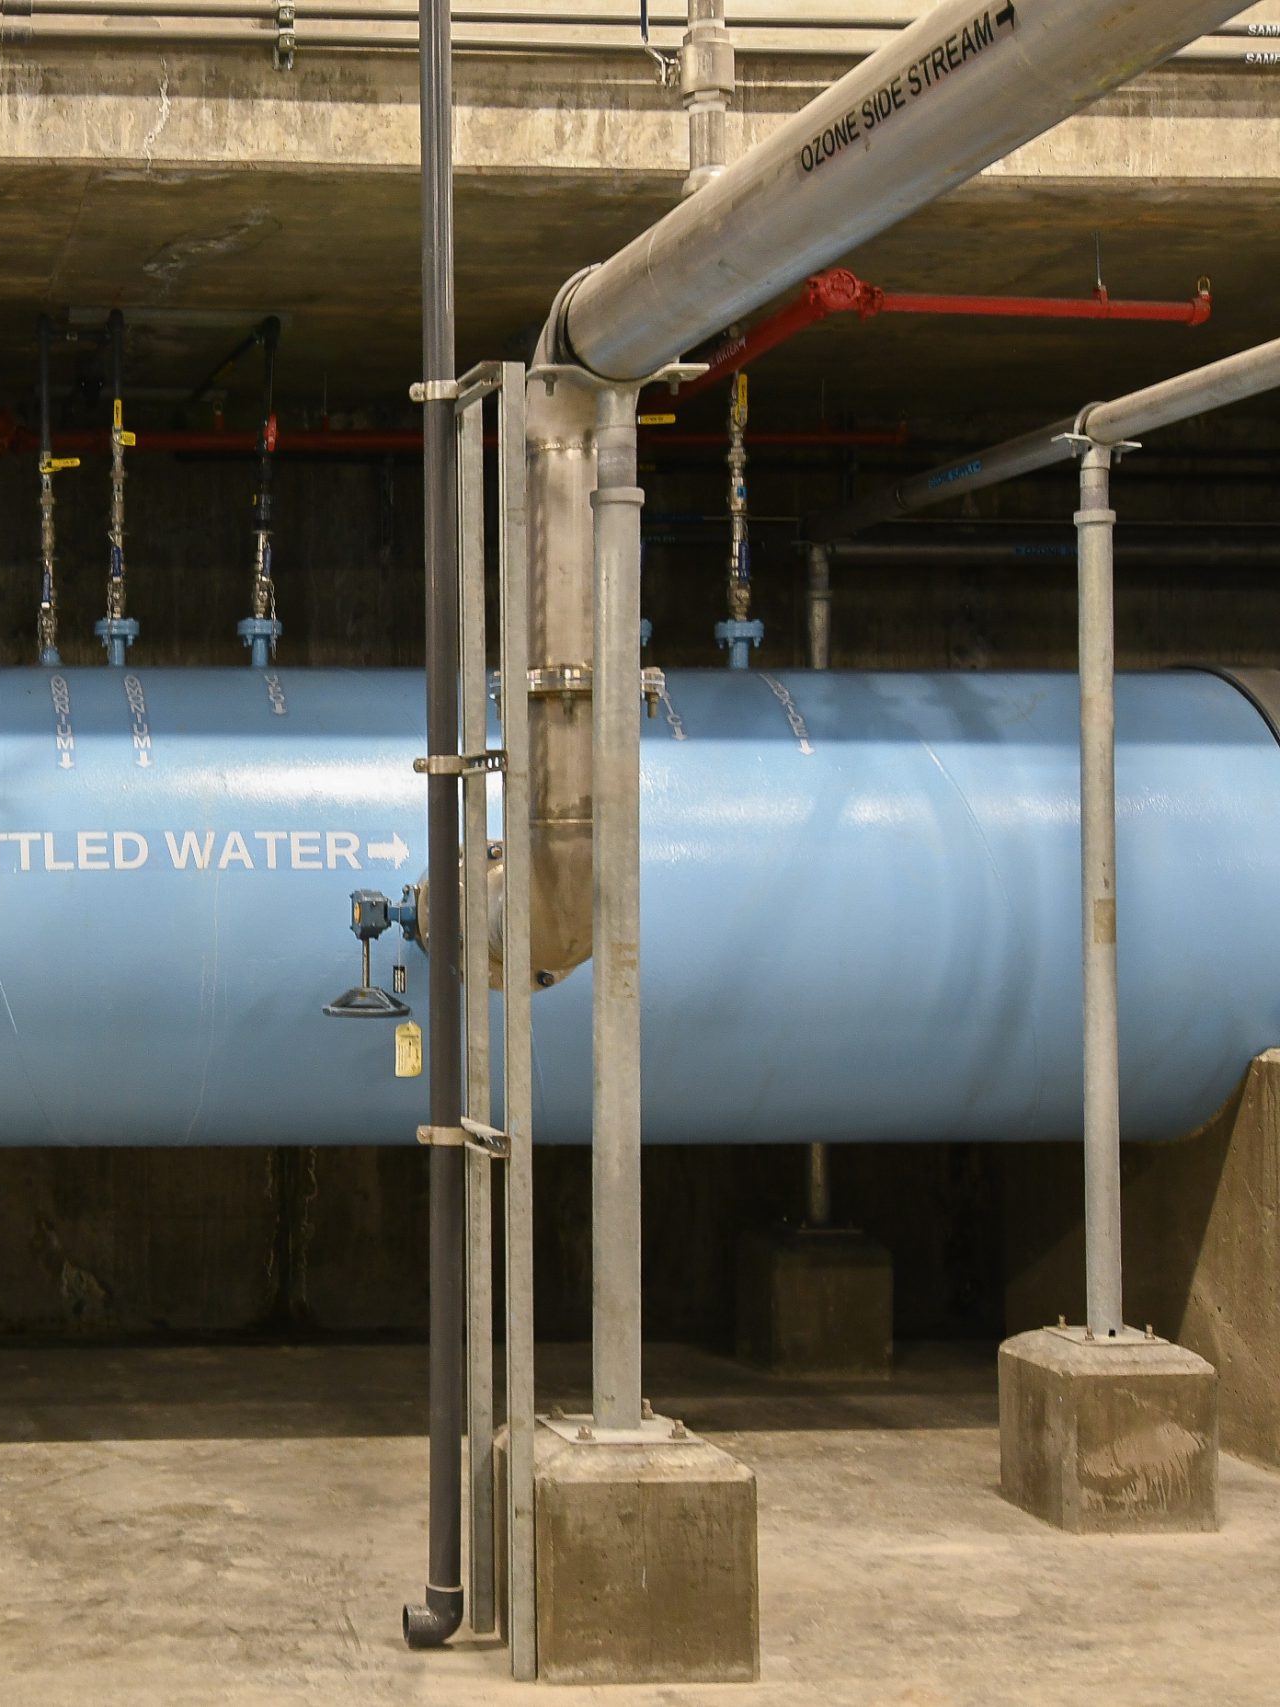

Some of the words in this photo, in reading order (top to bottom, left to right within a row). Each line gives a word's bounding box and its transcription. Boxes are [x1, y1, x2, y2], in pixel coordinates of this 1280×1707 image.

[800, 110, 861, 173] OZONE
[861, 75, 906, 130] SIDE
[907, 10, 995, 97] STREAM
[164, 829, 363, 872] WATER
